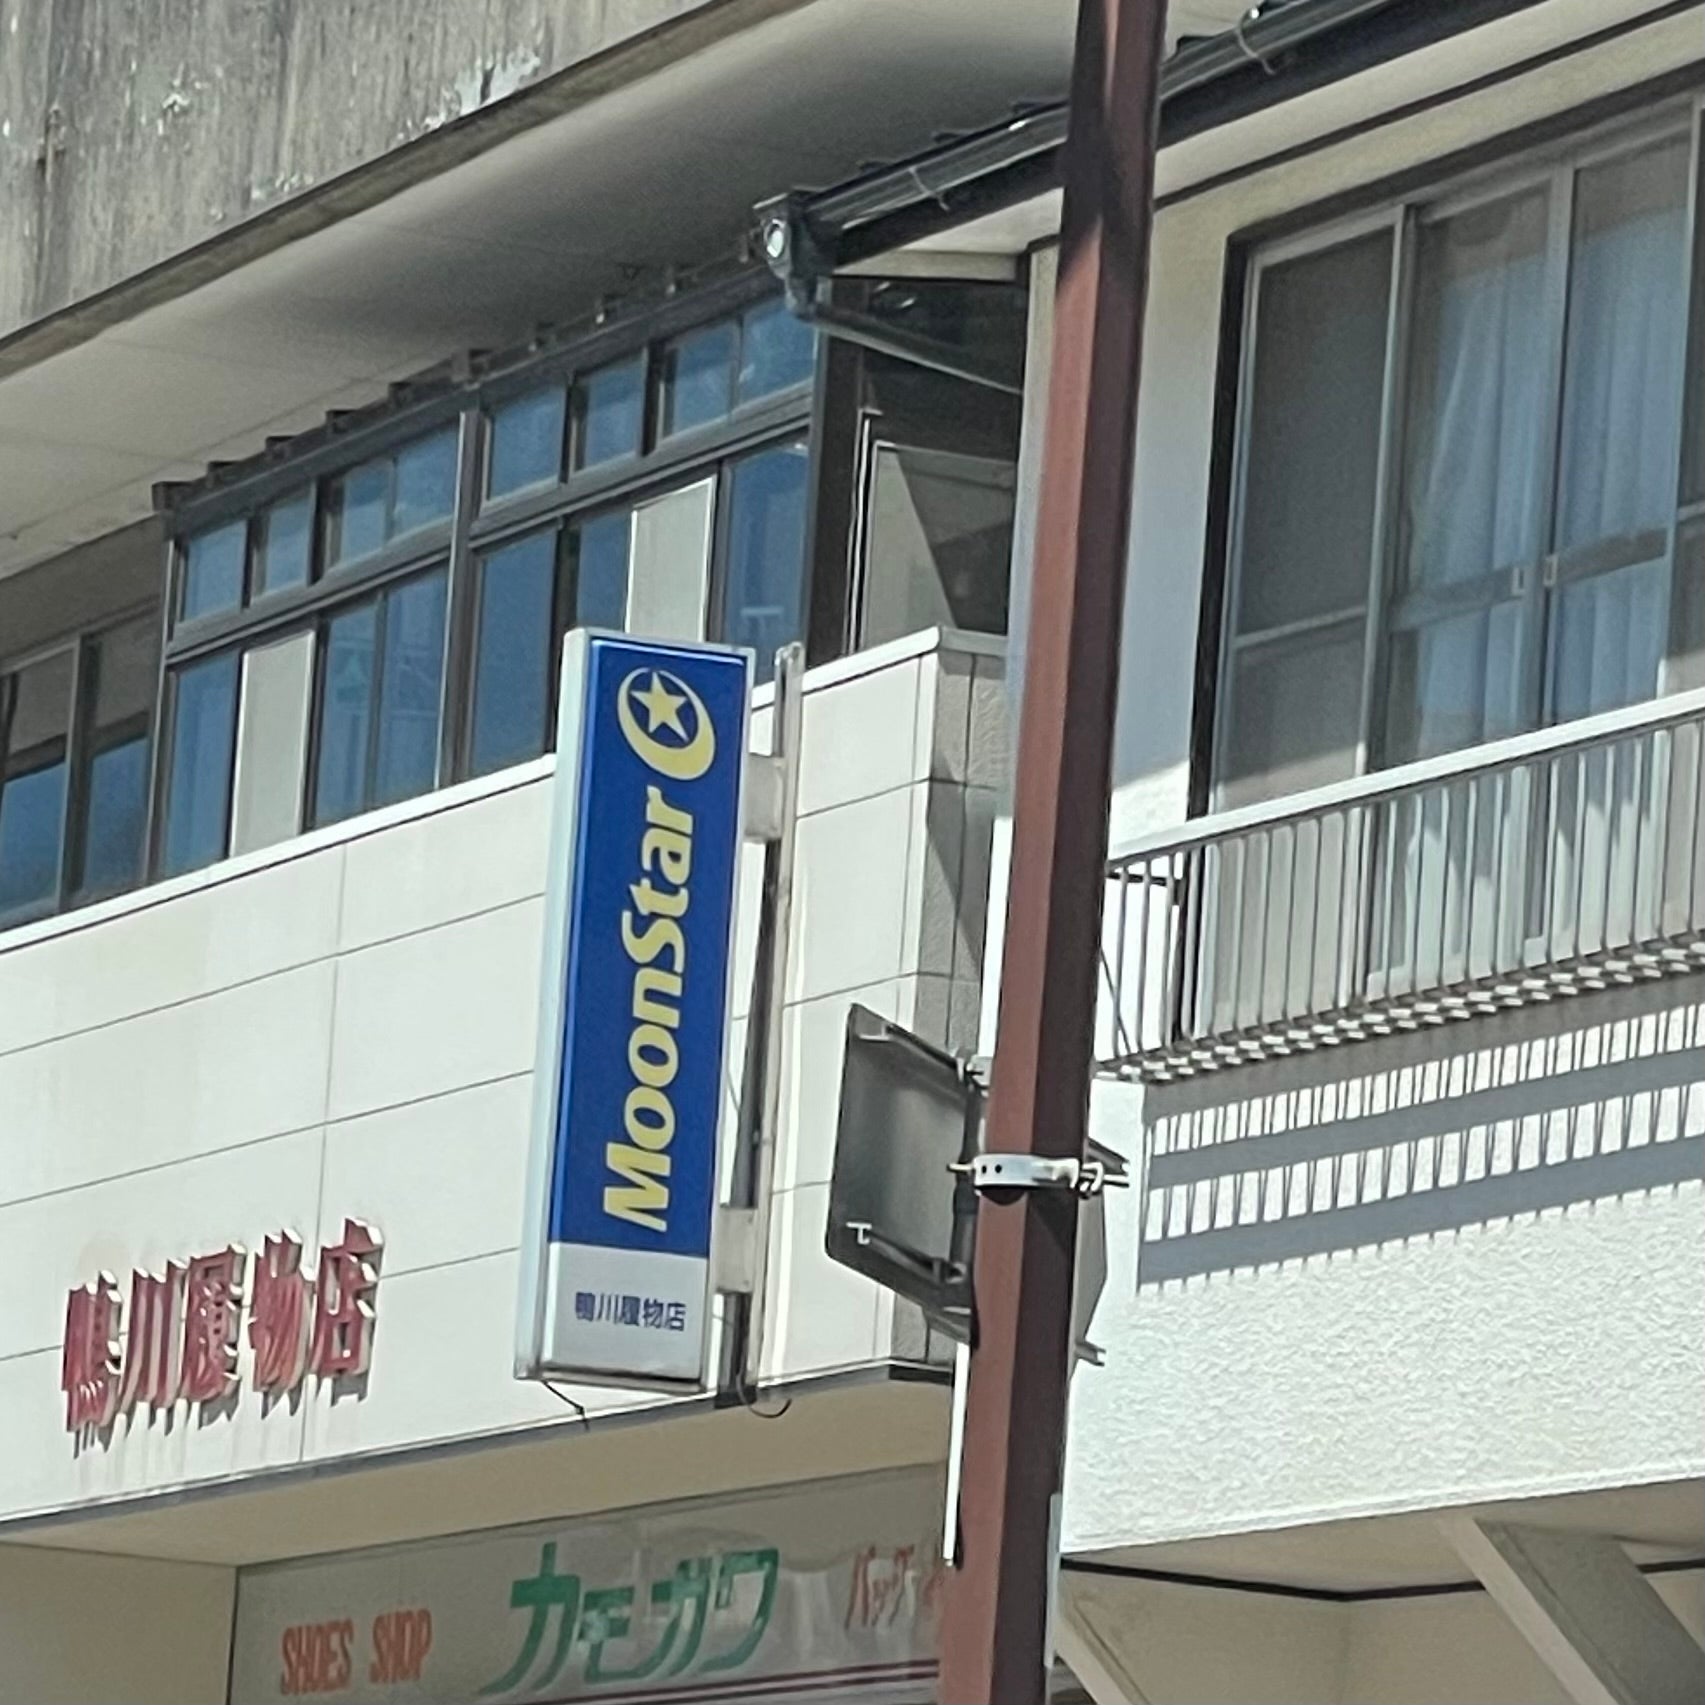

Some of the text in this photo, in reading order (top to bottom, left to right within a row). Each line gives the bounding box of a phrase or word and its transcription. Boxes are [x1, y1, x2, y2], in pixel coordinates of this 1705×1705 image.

[603, 786, 695, 1232] MoonStar
[280, 1607, 433, 1696] SHOES SHOP
[478, 1541, 779, 1697] カモガワ
